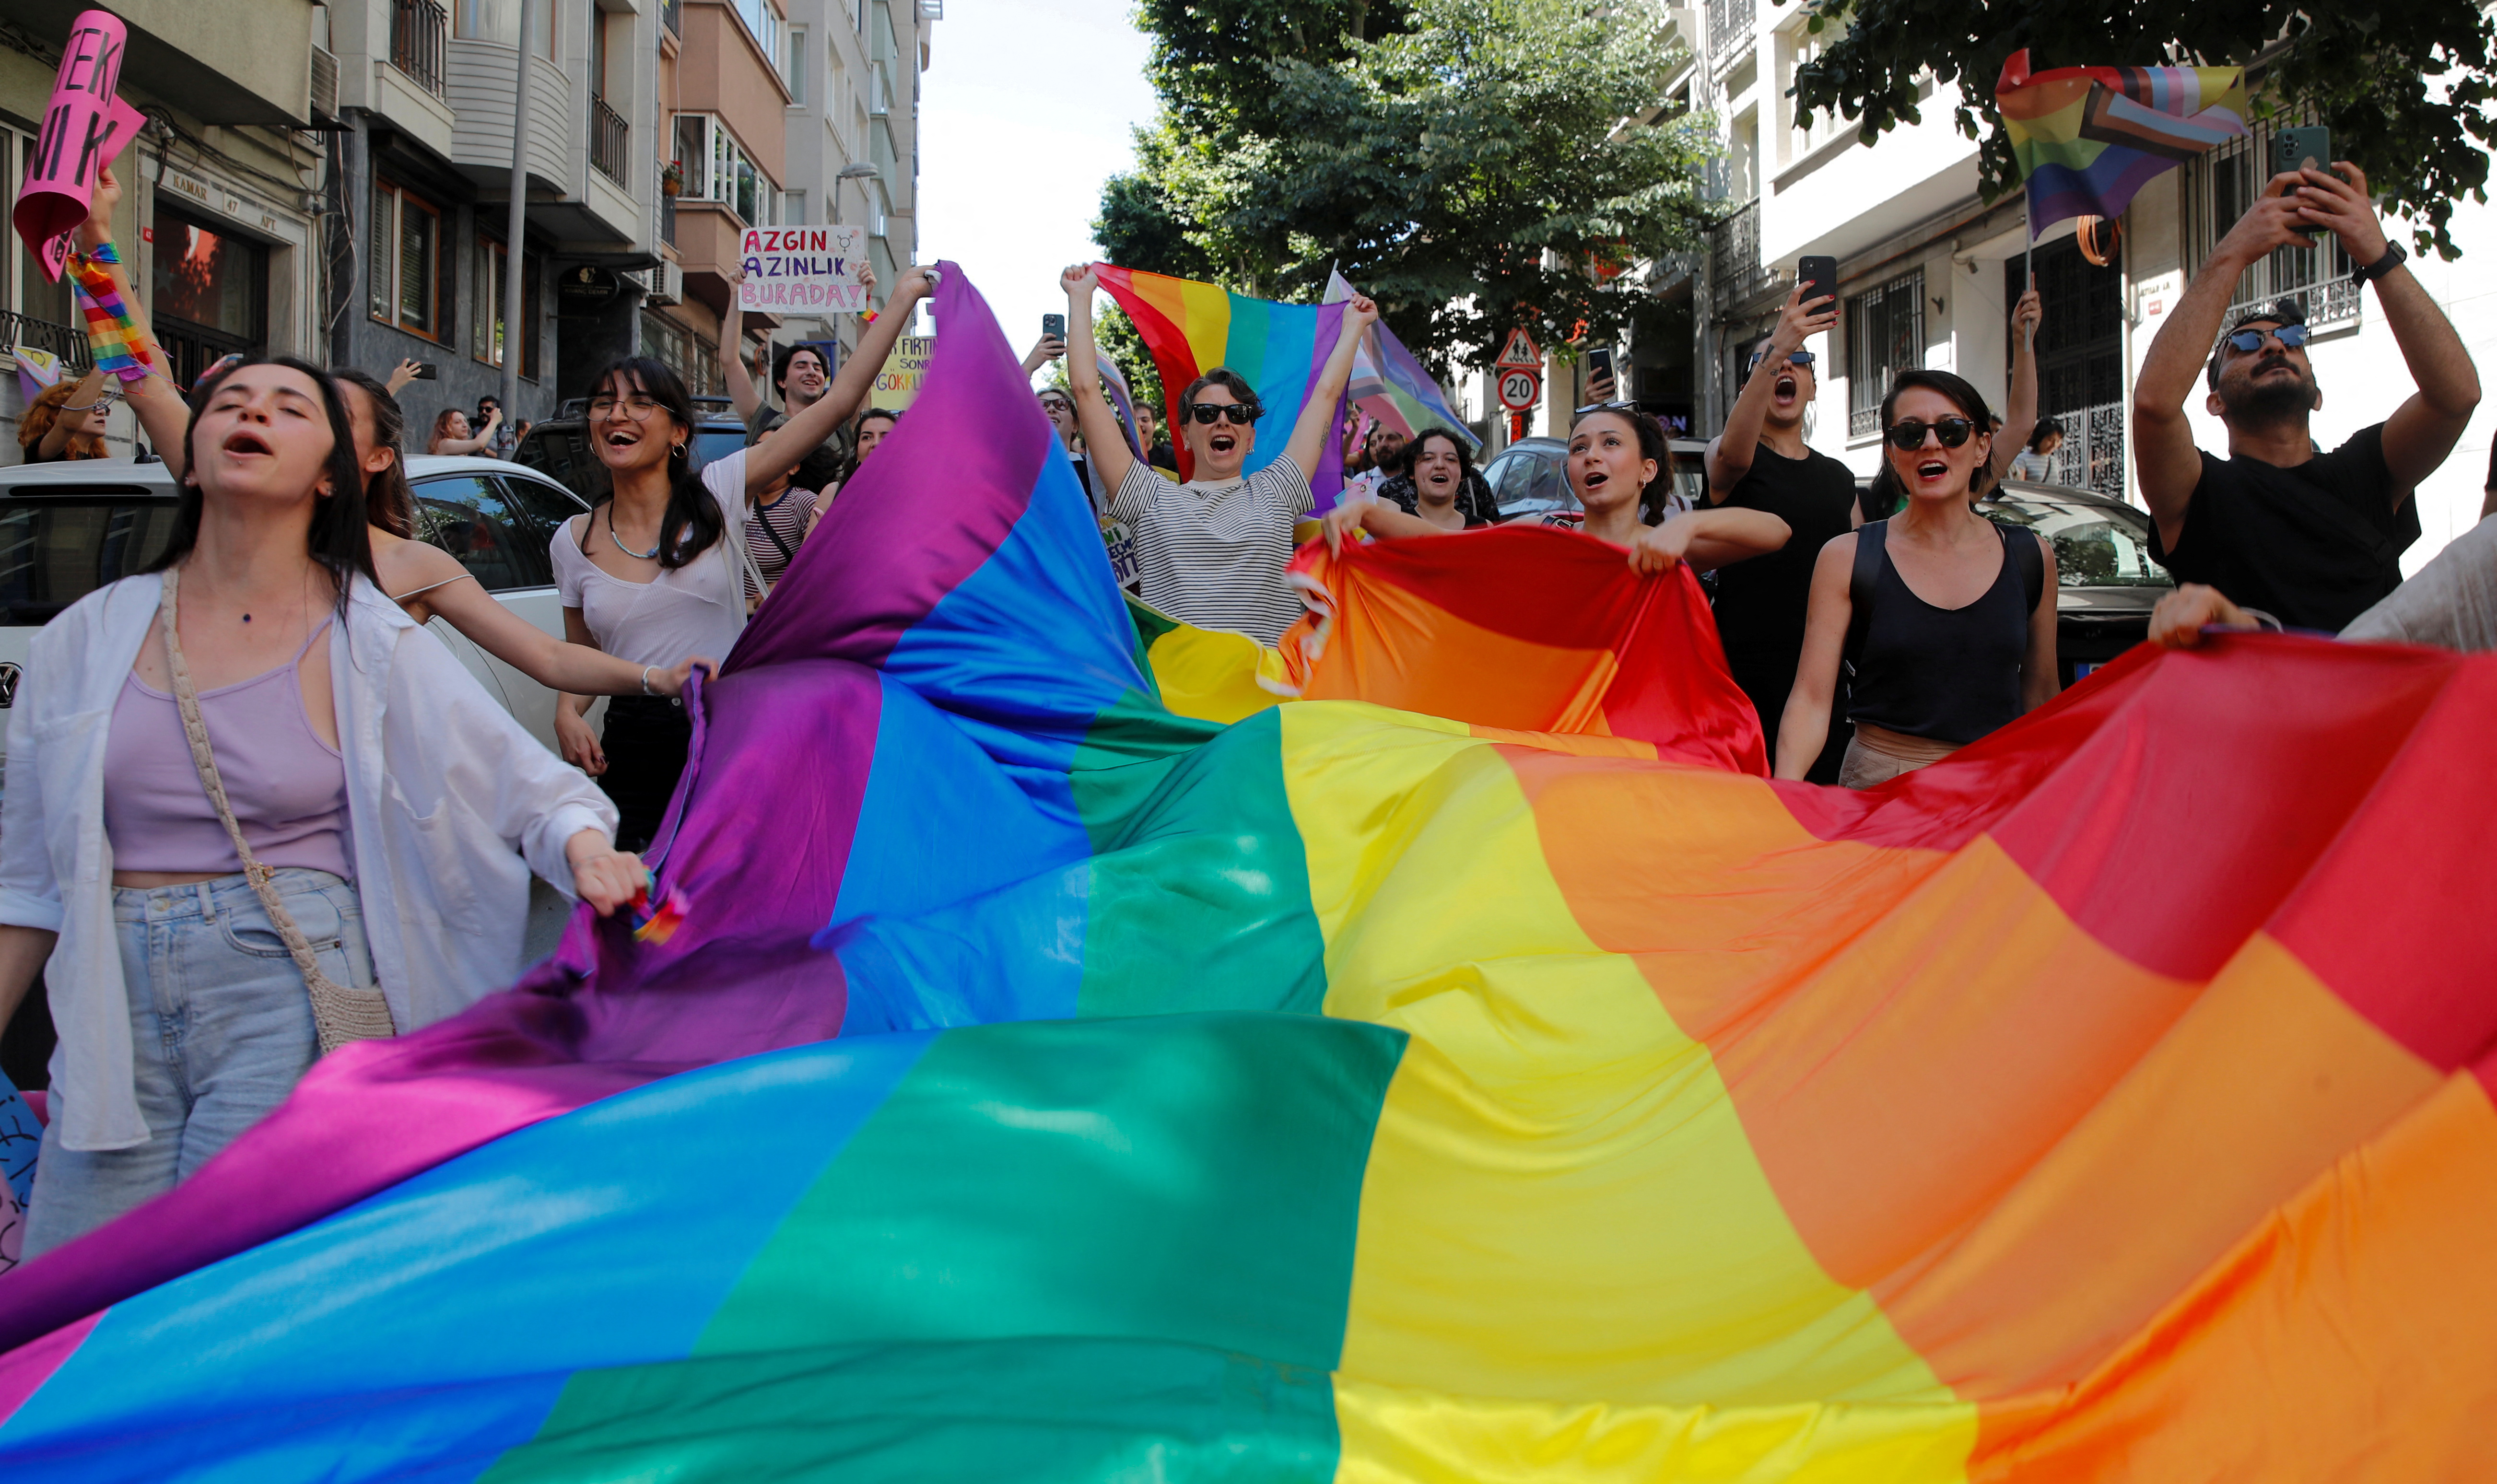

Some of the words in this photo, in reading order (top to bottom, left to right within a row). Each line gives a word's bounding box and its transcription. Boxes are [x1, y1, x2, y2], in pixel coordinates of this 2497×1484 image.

[173, 174, 208, 201] KAMAR
[227, 199, 238, 212] 47
[744, 230, 826, 254] AZGIN
[743, 257, 845, 278] AZINLIK
[742, 283, 862, 307] BURADA!
[900, 358, 933, 370] SONR
[876, 368, 929, 391] GÖKKU
[1507, 378, 1530, 398] 20
